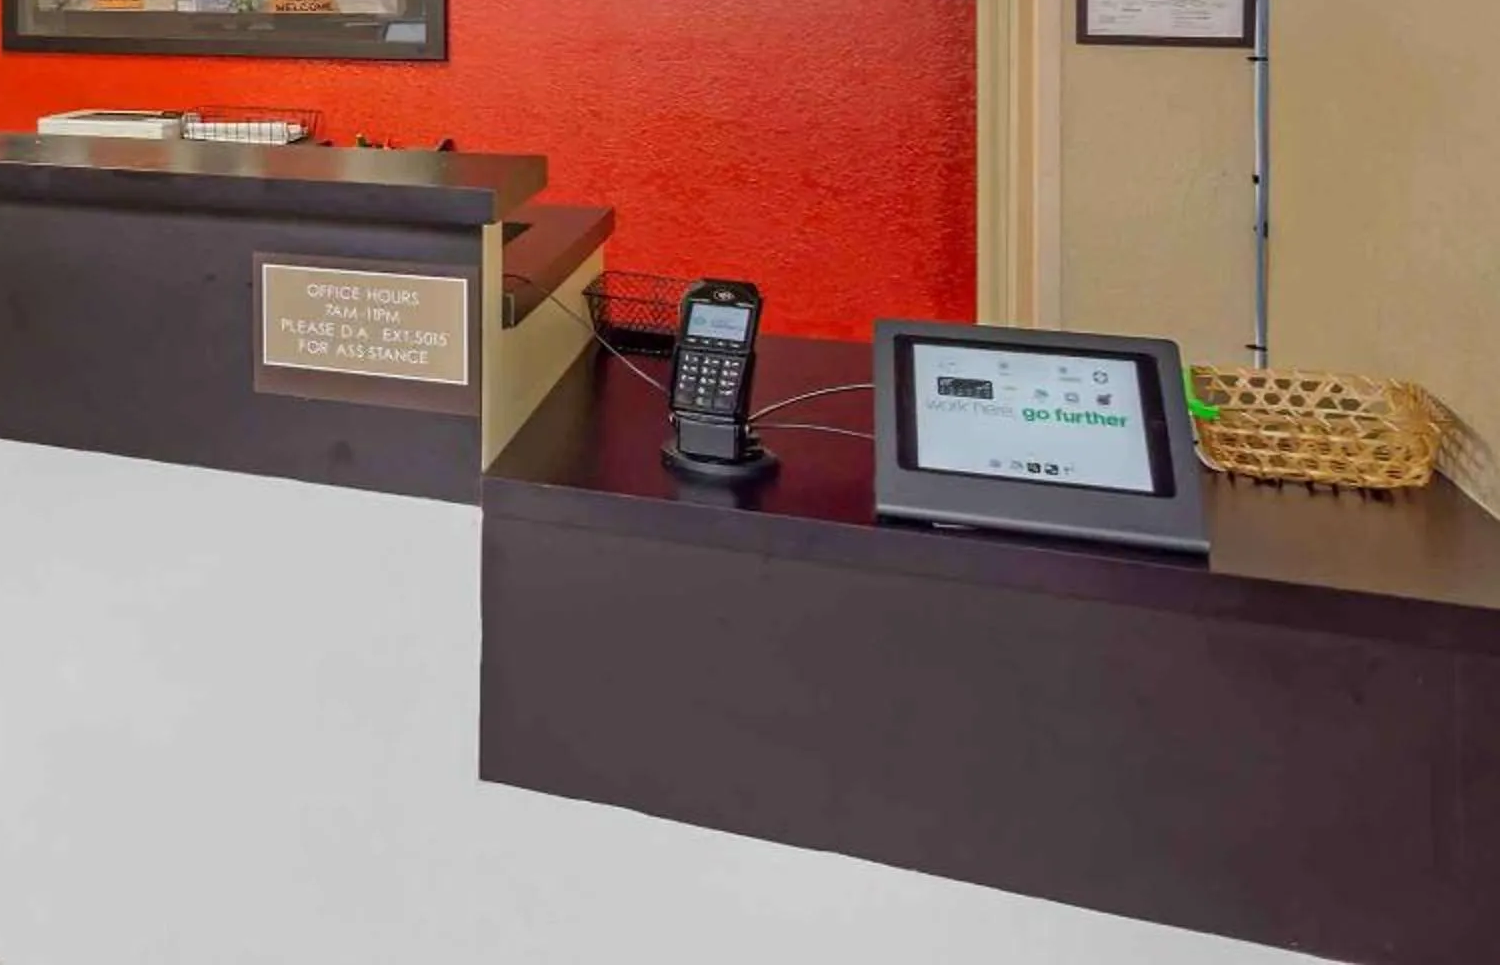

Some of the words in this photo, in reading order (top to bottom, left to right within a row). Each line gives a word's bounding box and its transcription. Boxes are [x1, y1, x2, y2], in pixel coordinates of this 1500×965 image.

[307, 283, 360, 300] OFFICE
[366, 288, 420, 306] HOURS
[281, 318, 335, 337] PLEASE
[298, 339, 328, 355] FOR
[336, 344, 429, 364] ASSSTANCE
[1022, 407, 1049, 422] go
[1055, 409, 1128, 428] further
